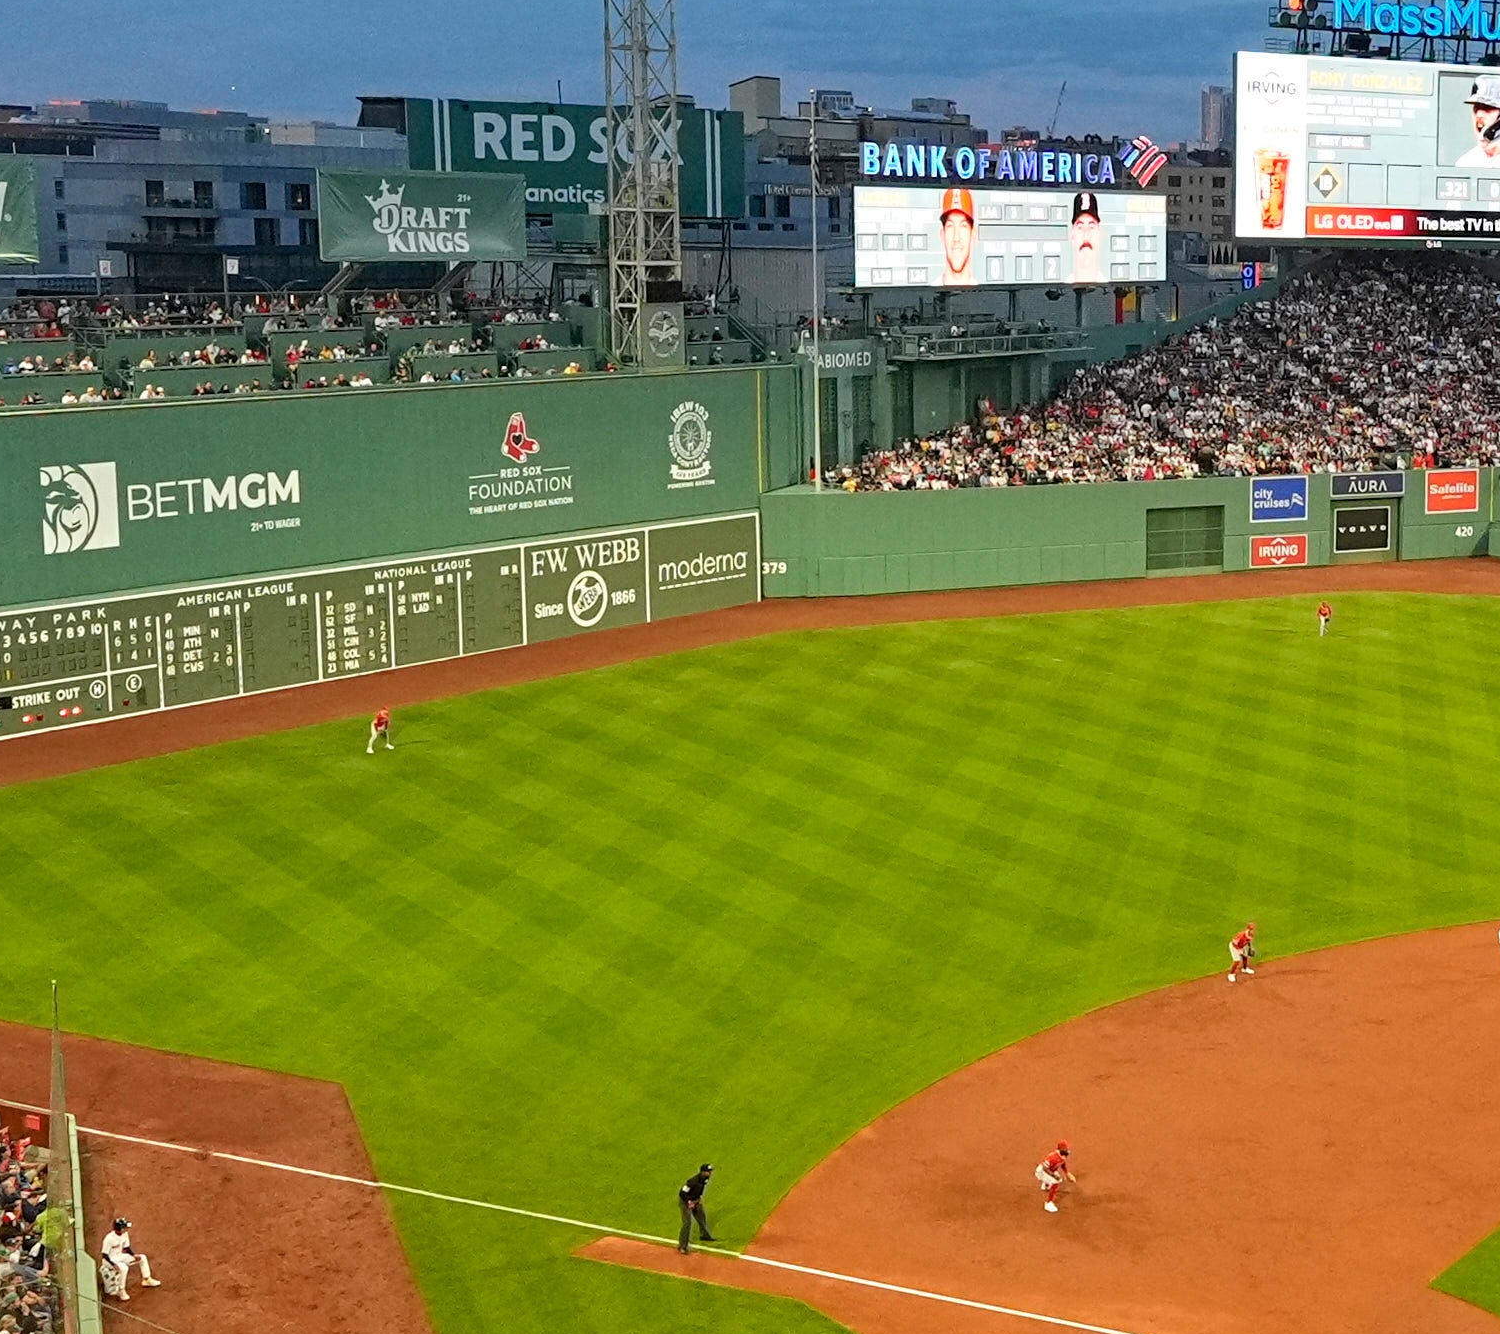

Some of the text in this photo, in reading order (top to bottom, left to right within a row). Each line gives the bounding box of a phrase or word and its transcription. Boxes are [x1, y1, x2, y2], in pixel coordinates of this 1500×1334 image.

[1247, 81, 1297, 95] IRVING
[473, 112, 576, 162] RED
[860, 140, 1117, 186] BANK OF AMERICA
[524, 183, 605, 204] anatics
[373, 201, 472, 235] DRAFT
[1314, 214, 1374, 230] LG OLED
[1416, 216, 1439, 231] The
[1440, 217, 1464, 232] best
[1465, 218, 1483, 232] TV
[387, 226, 470, 254] KINGS
[817, 351, 872, 369] ABIOMED
[501, 465, 542, 478] RED SOX
[127, 469, 301, 520] BETMGM
[469, 475, 572, 501] FOUNDATION
[1253, 489, 1273, 502] city
[1429, 483, 1476, 496] Safelite
[549, 496, 573, 509] NATION
[1253, 497, 1290, 509] cruises
[1338, 524, 1387, 534] VOLVO
[1455, 525, 1474, 537] 420
[574, 537, 641, 569] WEBB
[1258, 543, 1299, 558] IRVING
[374, 558, 472, 580] NATIONAL LEAGUE
[658, 550, 749, 583] moderna
[762, 561, 787, 575] 379
[176, 581, 294, 608] AMERICAN LEAGUE
[534, 588, 636, 619] Since 1866
[53, 607, 107, 625] PARK
[11, 692, 52, 709] STRIKE
[55, 686, 81, 701] OUT
